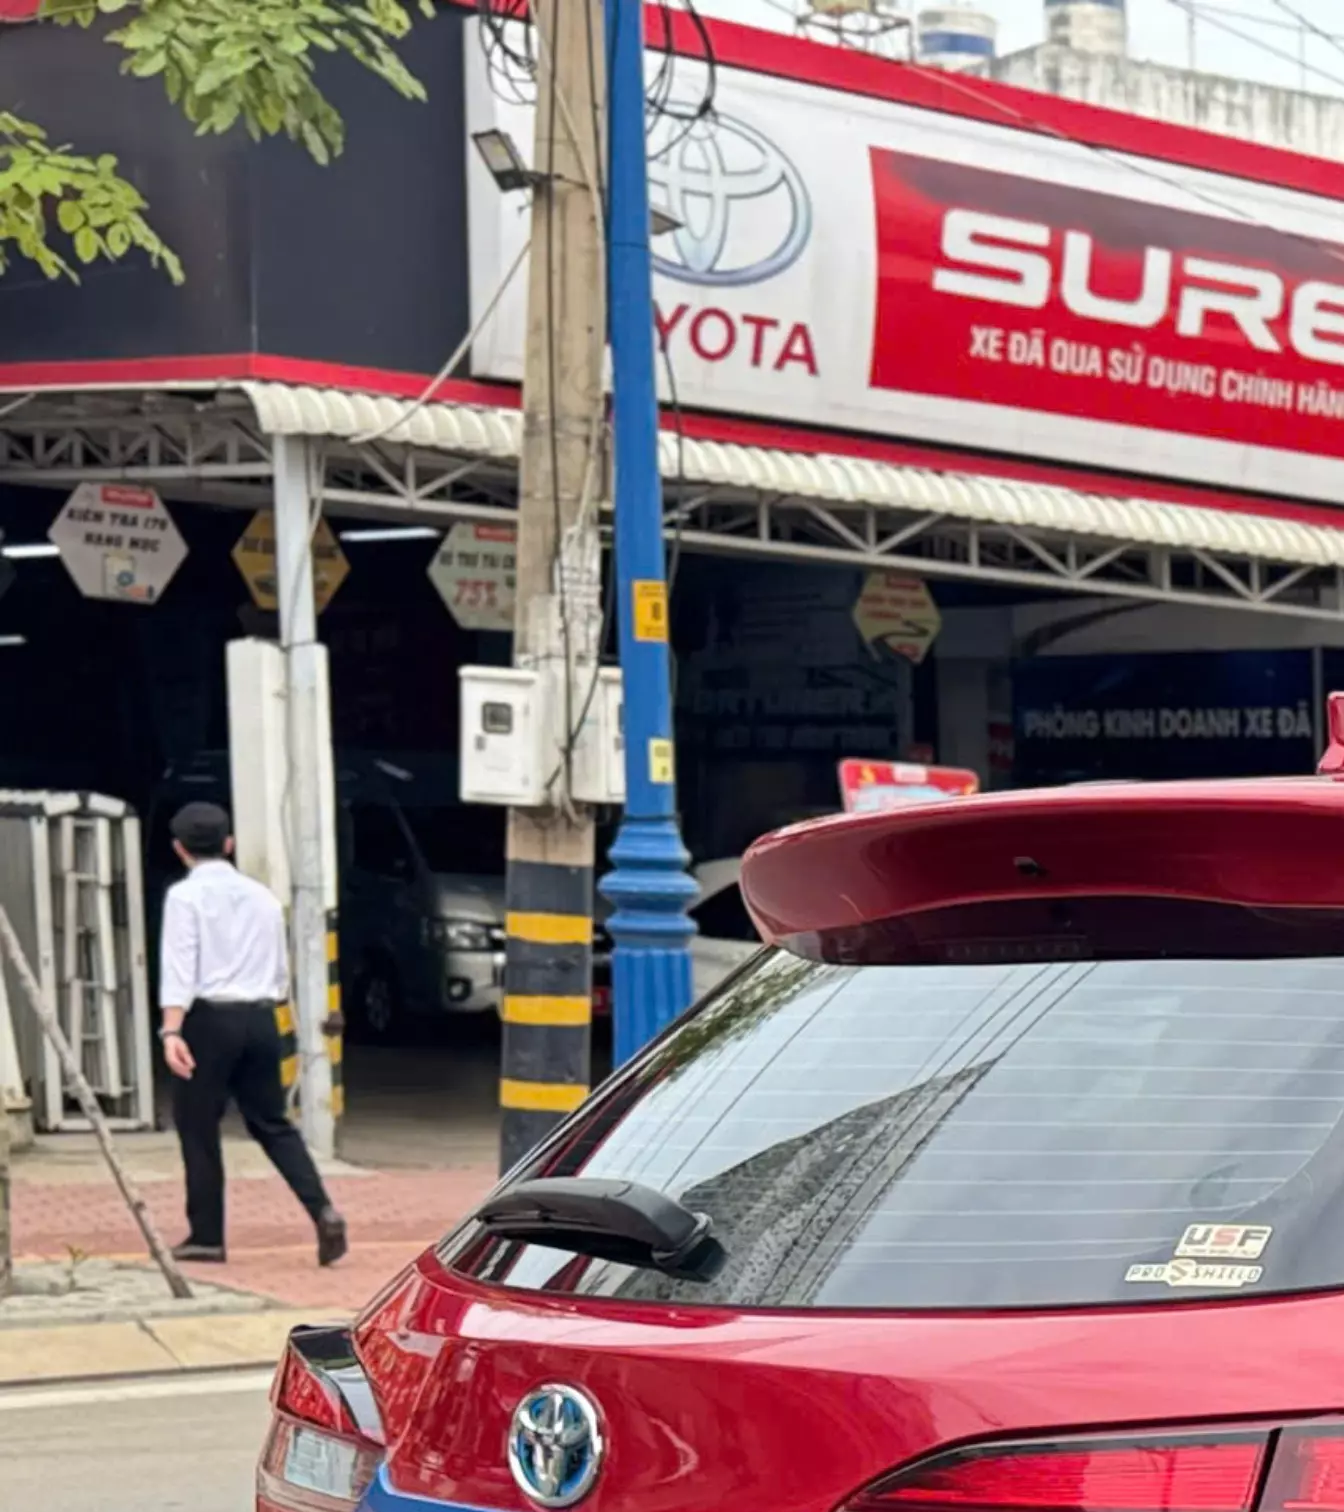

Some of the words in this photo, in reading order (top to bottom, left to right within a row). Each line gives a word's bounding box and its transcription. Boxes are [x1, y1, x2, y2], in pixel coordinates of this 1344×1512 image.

[653, 299, 819, 377] YOTA
[969, 325, 1004, 361] XE
[1007, 328, 1046, 369] ĐÃ
[1051, 338, 1103, 377] QUA
[1108, 341, 1147, 384] SỬ
[1147, 356, 1217, 397] DỤNG
[1221, 368, 1294, 411] CHÍNH
[1024, 701, 1099, 739] PHÒNG
[1103, 708, 1155, 738] KINH
[1159, 708, 1240, 739] DOANH
[1245, 707, 1273, 738] XE
[1277, 699, 1312, 739] ĐÃ
[1184, 1226, 1268, 1247] USF
